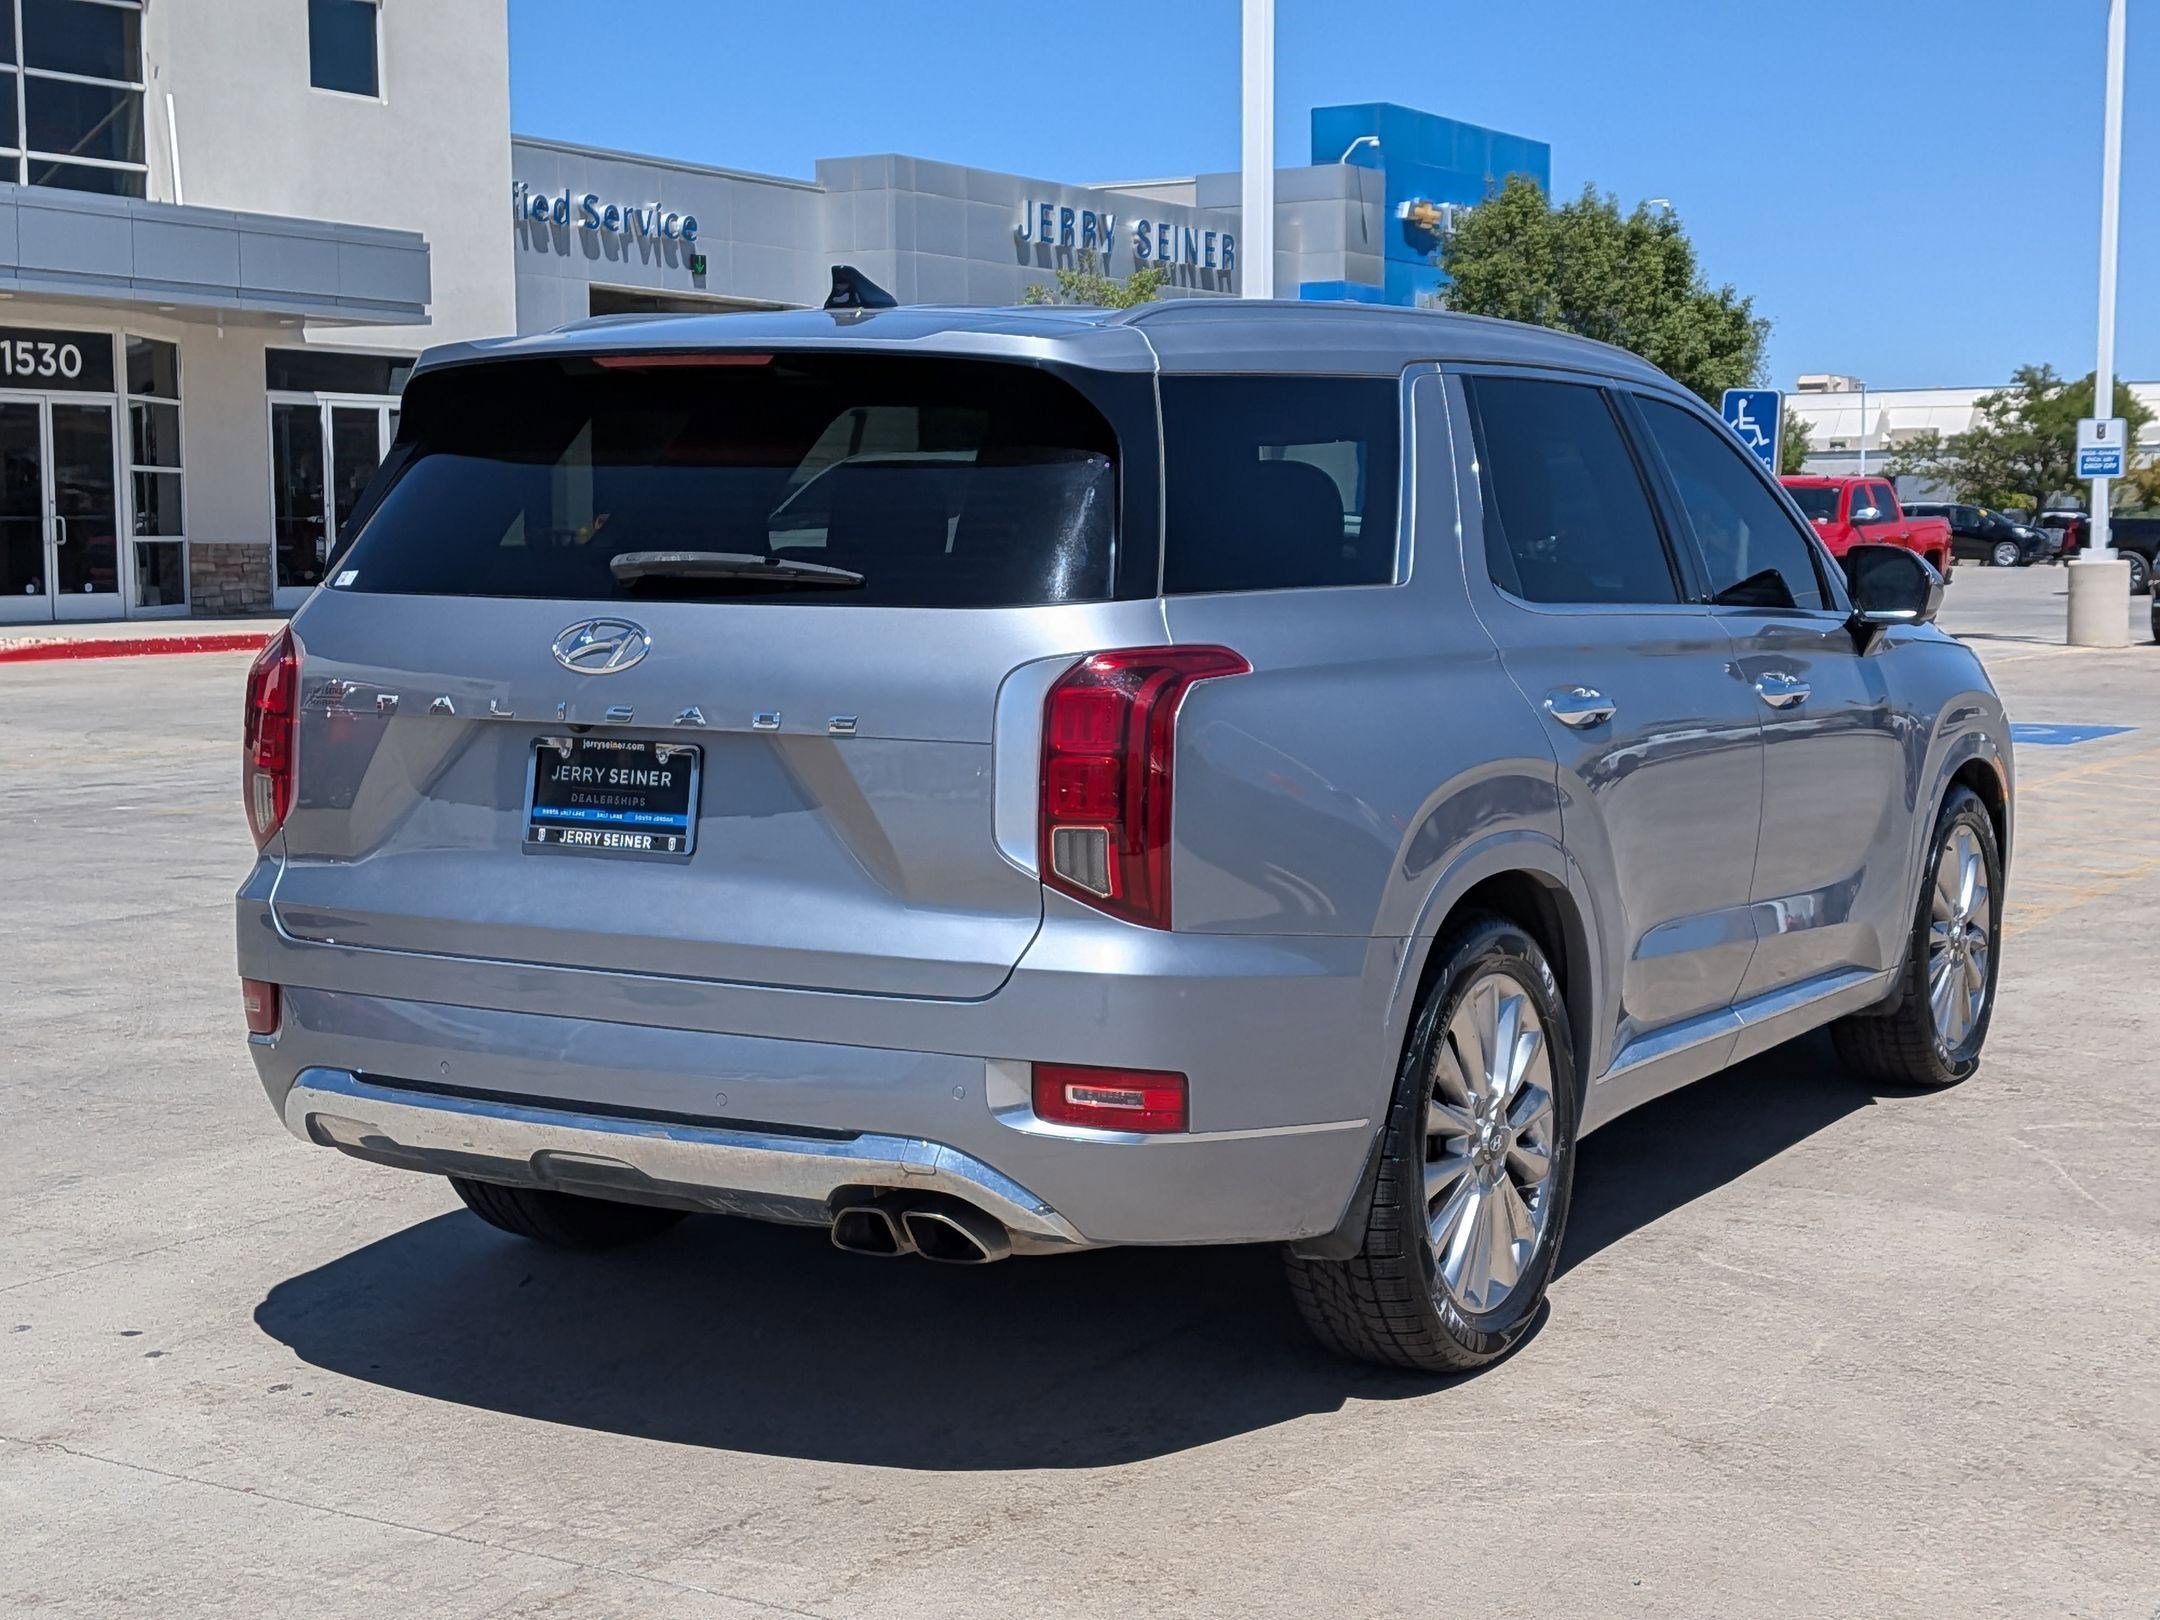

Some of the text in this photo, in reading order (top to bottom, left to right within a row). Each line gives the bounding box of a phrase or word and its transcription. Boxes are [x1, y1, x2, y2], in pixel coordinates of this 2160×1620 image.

[580, 193, 698, 242] Service
[1017, 199, 1235, 271] JERRY SEINER
[0, 340, 82, 378] 1530
[376, 694, 860, 735] PALISADE
[582, 738, 645, 752] jerryseiner.com
[551, 765, 672, 787] JERRY SEINER
[571, 792, 646, 807] DEALERSHIPS
[559, 830, 652, 849] JERRY SEINER
